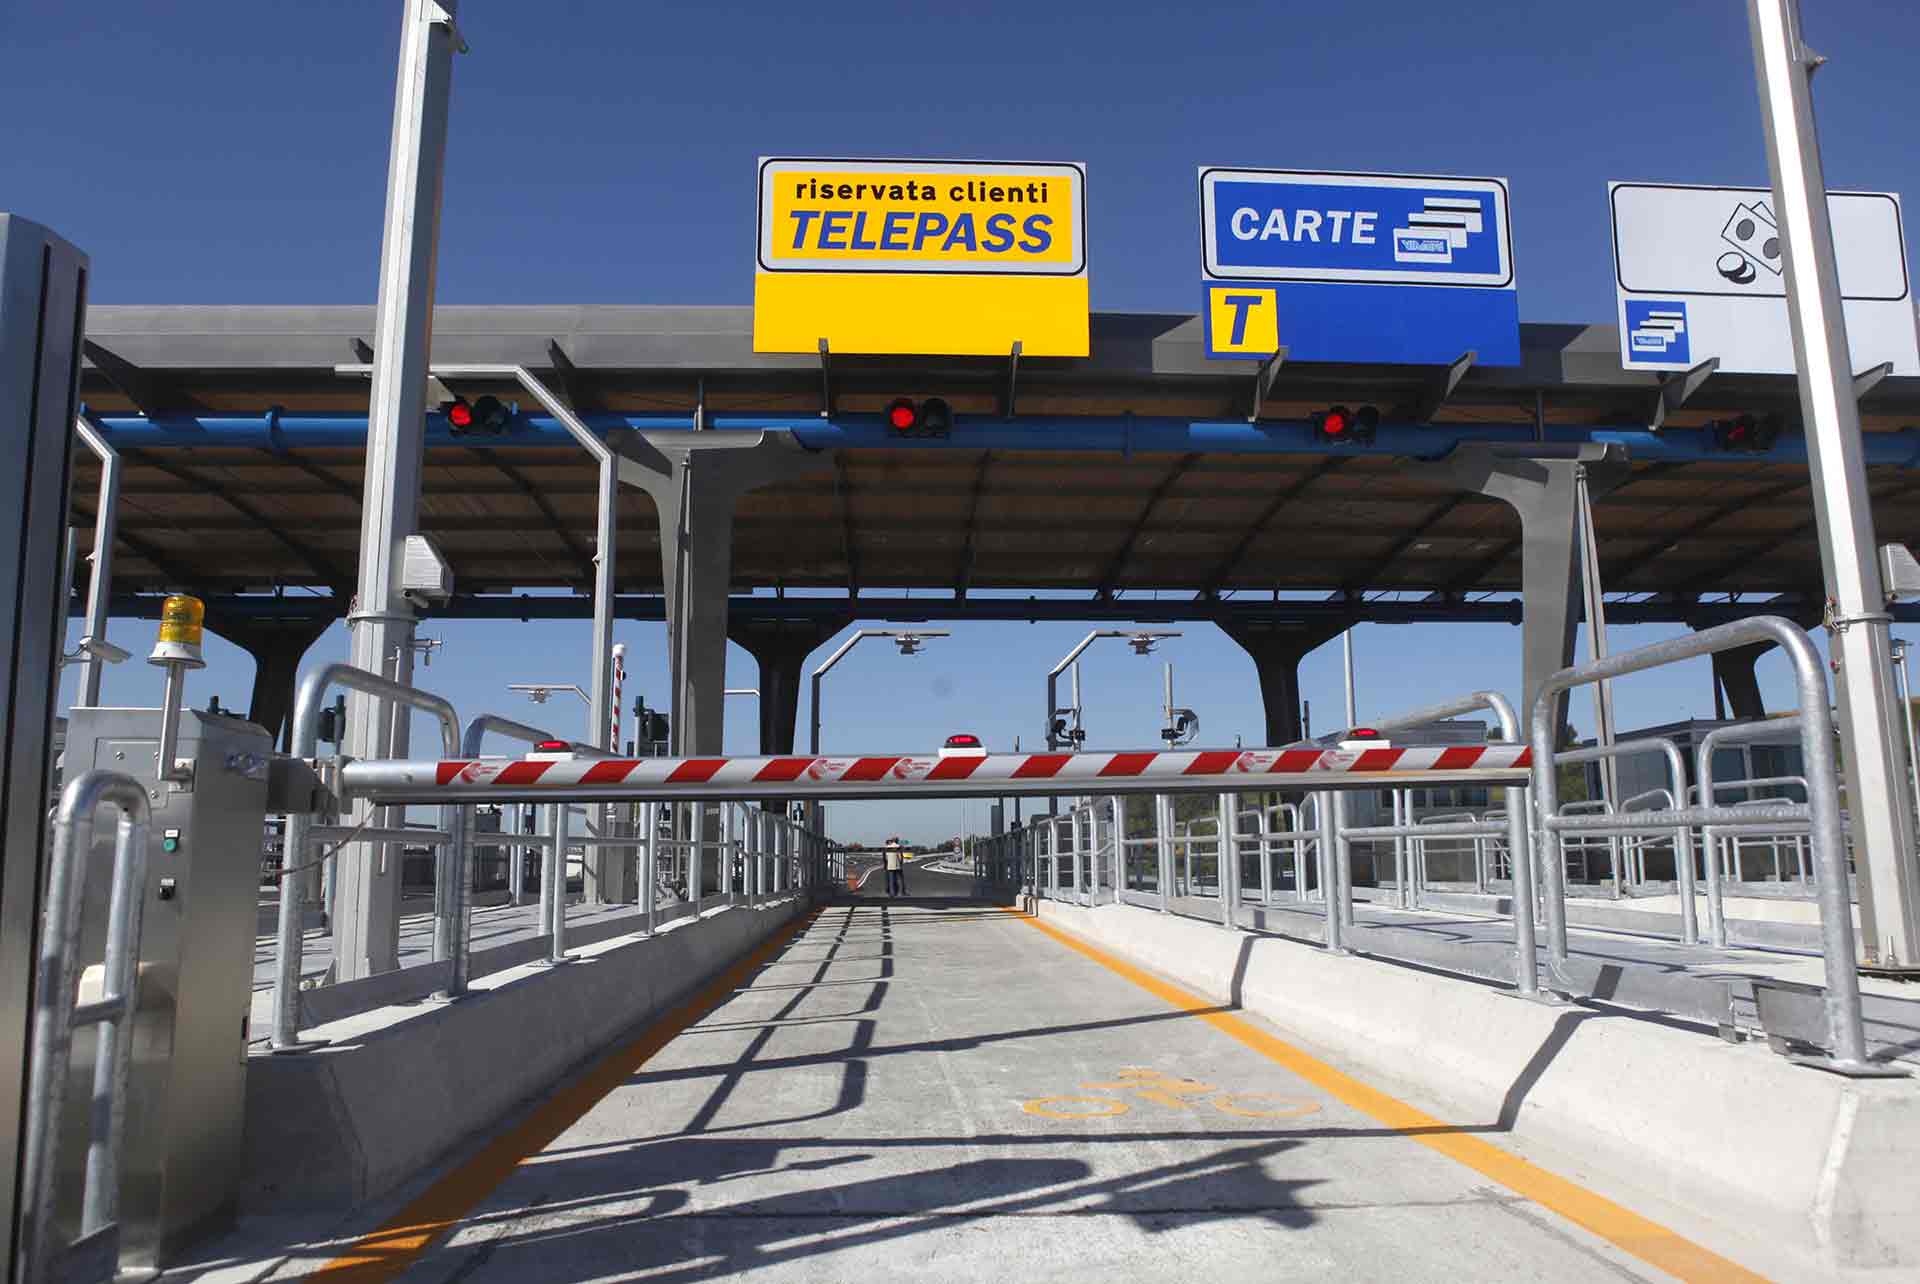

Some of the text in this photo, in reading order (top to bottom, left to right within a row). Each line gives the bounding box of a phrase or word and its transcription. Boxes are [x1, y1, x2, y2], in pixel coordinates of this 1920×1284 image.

[796, 179, 1048, 203] riservata clienti
[789, 210, 1054, 253] TELEPASS
[1231, 207, 1378, 244] CARTE
[1224, 295, 1262, 345] T
